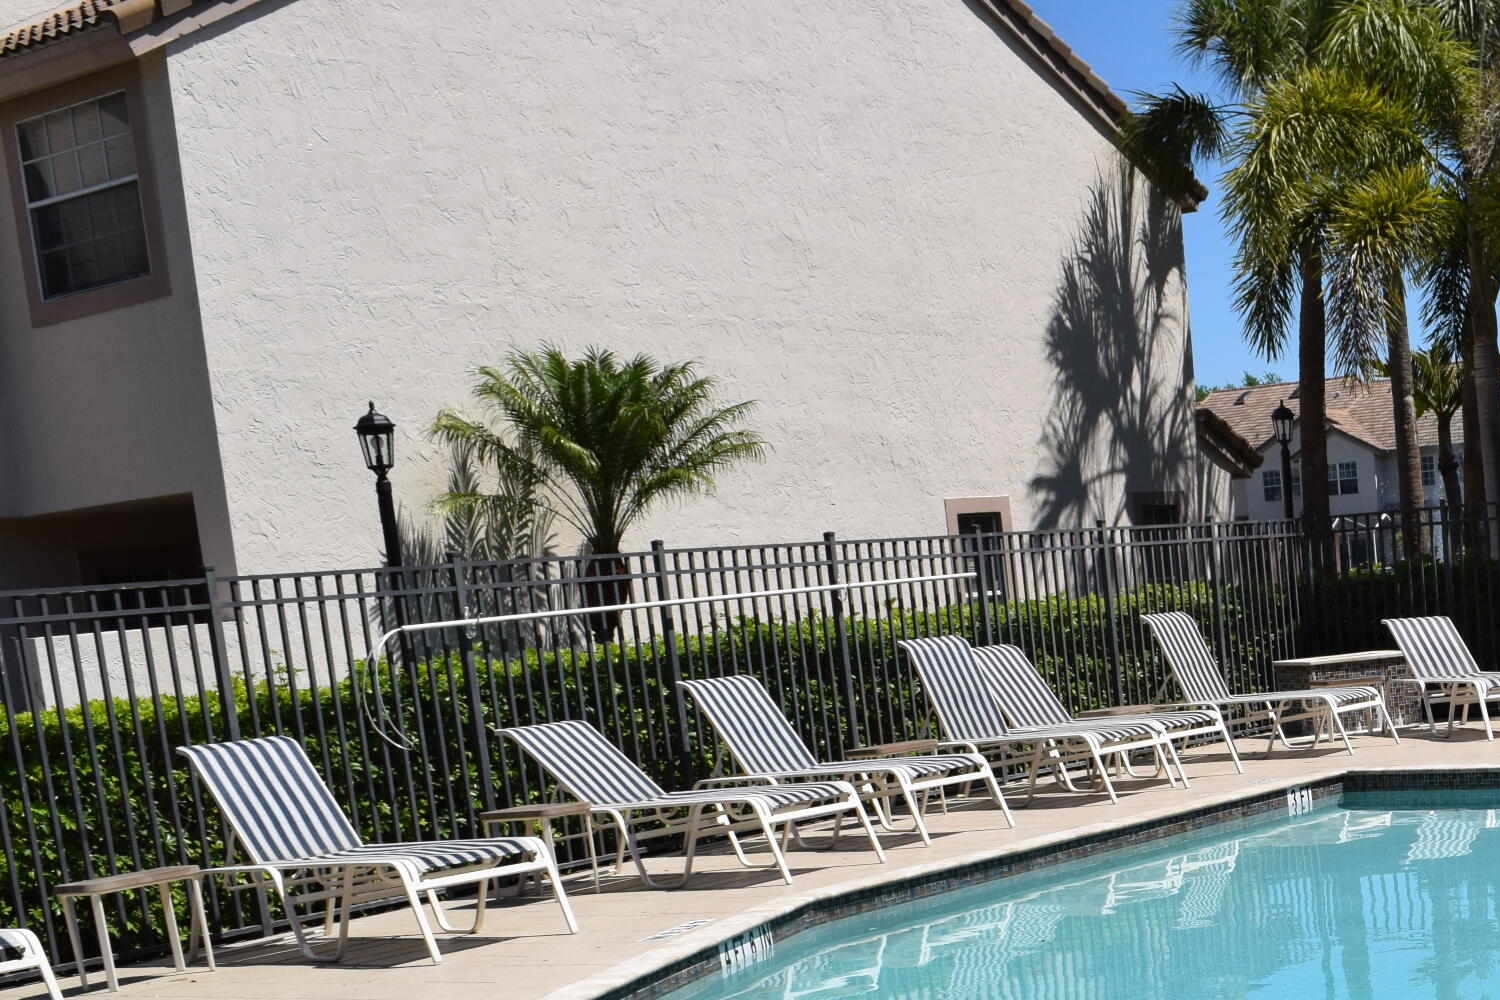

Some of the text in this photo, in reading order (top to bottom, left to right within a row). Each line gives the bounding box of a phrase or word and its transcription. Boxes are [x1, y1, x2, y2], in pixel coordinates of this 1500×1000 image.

[724, 921, 772, 964] 4 FT 6 IN
